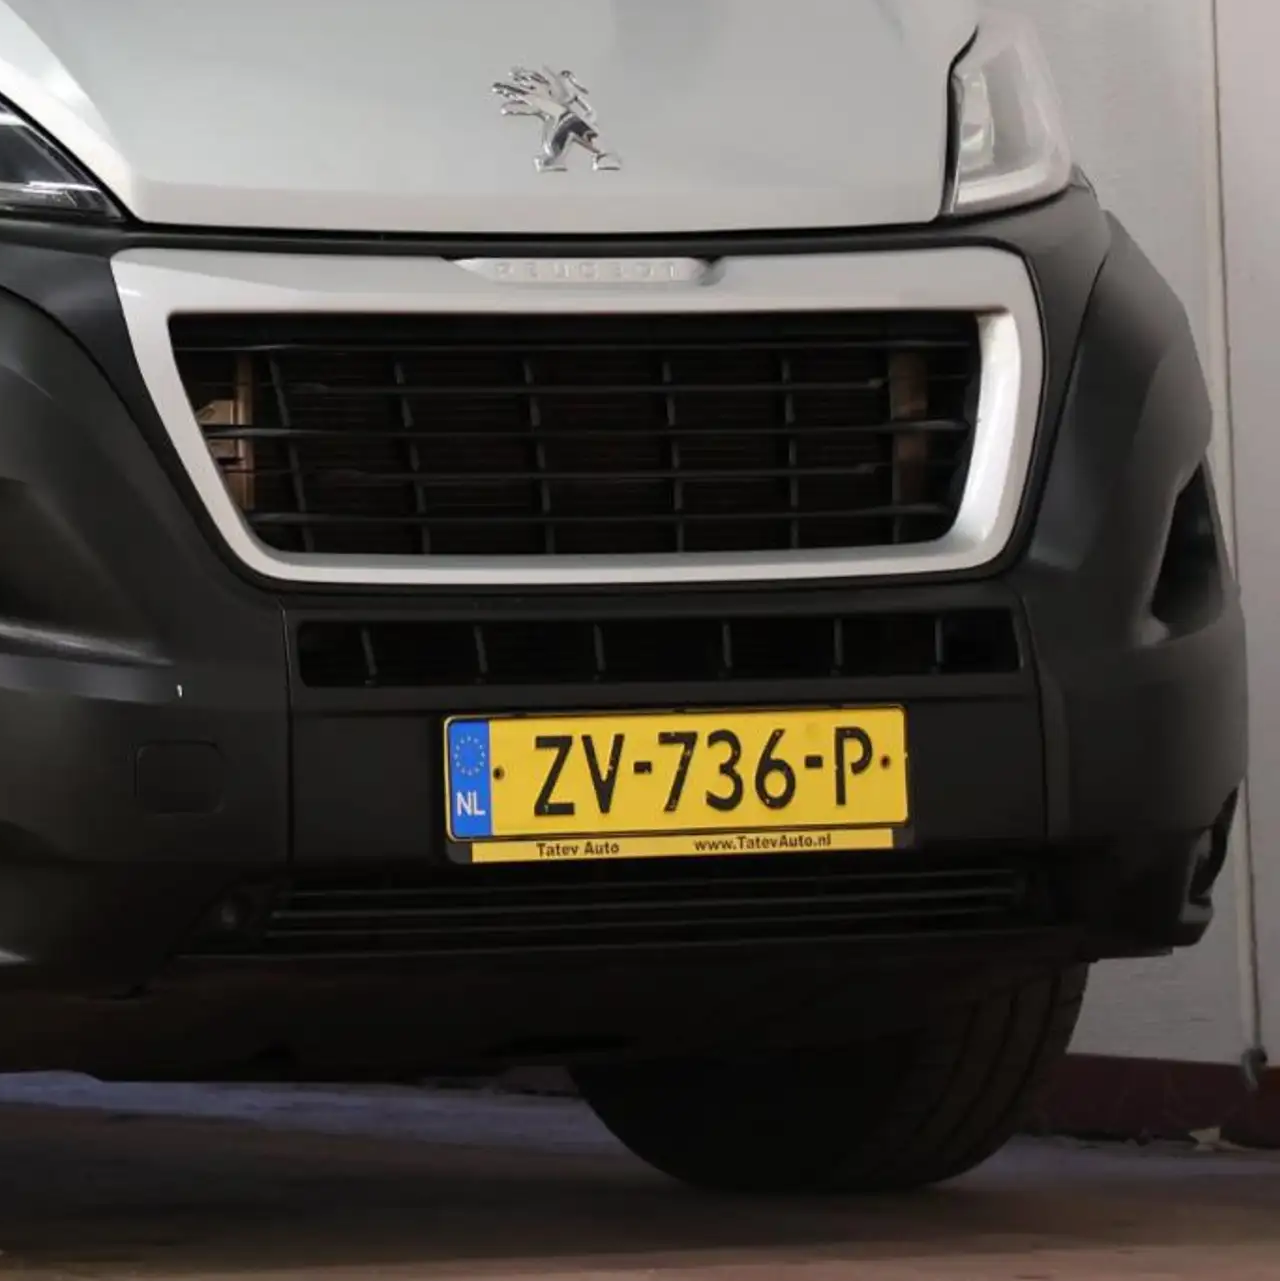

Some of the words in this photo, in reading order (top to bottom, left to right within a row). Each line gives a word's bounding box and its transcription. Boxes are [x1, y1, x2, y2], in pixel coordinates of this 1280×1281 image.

[533, 726, 874, 817] ZV-736-P
[457, 791, 486, 817] NL
[536, 841, 580, 858] Tatev
[583, 840, 619, 856] Auto
[693, 832, 832, 851] www.TatevAuto.nl
